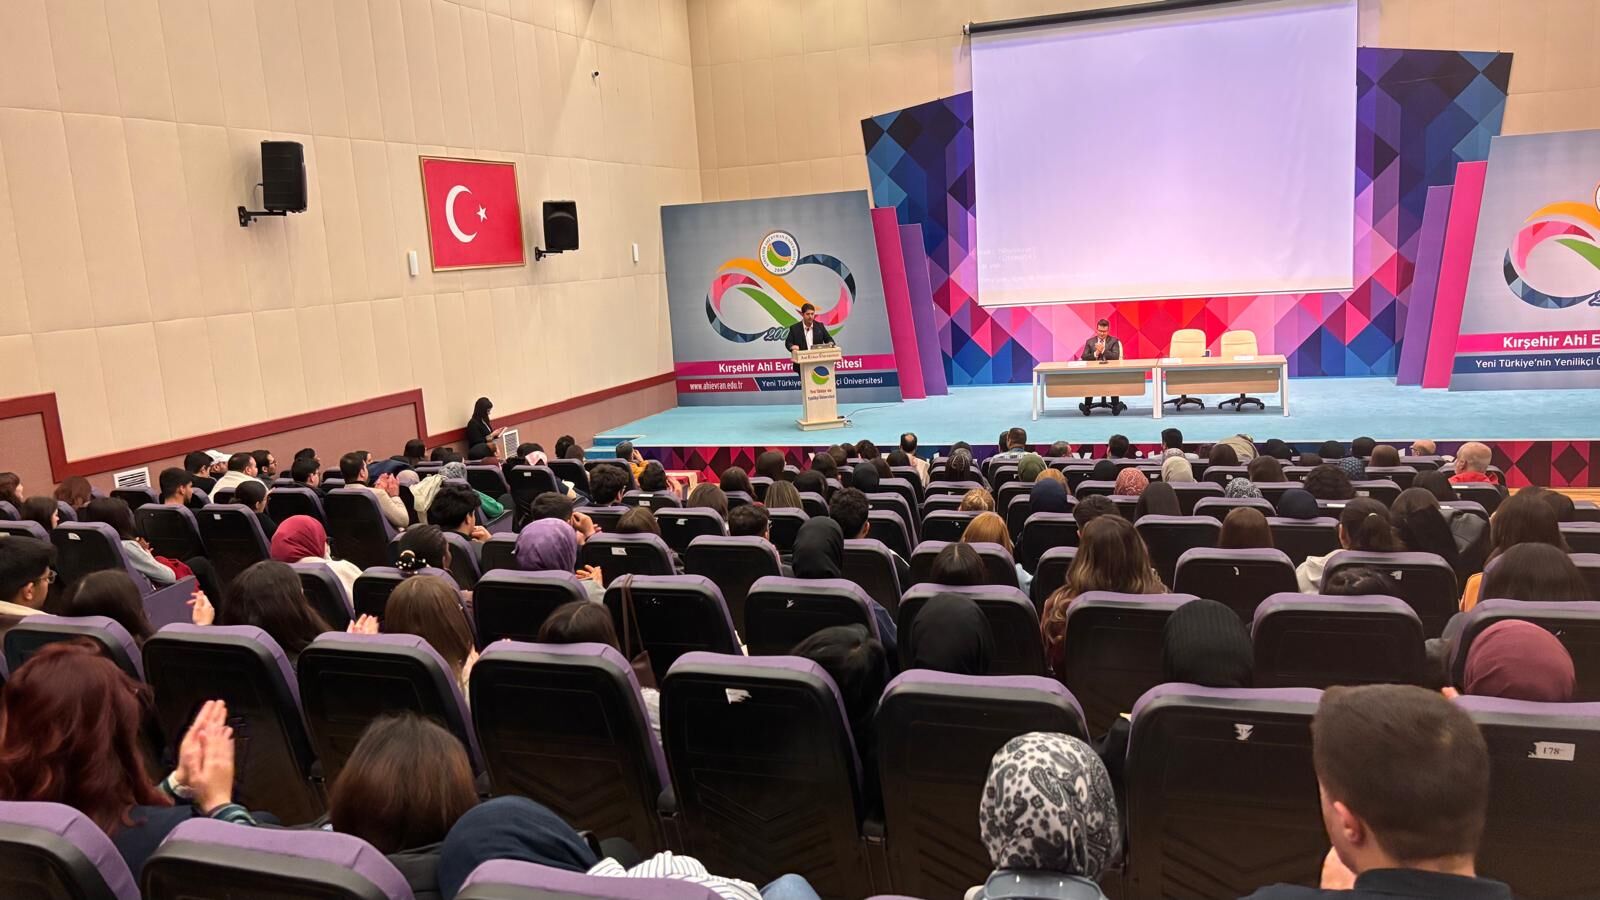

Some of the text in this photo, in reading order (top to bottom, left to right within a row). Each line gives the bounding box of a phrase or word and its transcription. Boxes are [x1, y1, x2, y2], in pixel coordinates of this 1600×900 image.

[764, 327, 790, 341] 200
[1503, 335, 1559, 349] Kırşehir
[1563, 334, 1587, 346] Ahi
[718, 362, 755, 374] Kırşehir
[757, 361, 773, 371] Ahi
[1475, 360, 1496, 368] Yeni
[1499, 358, 1551, 368] Türkiye'nin
[1553, 356, 1594, 367] Yenilikçi
[761, 380, 776, 388] Yeni
[843, 376, 883, 385] Üniversitesi
